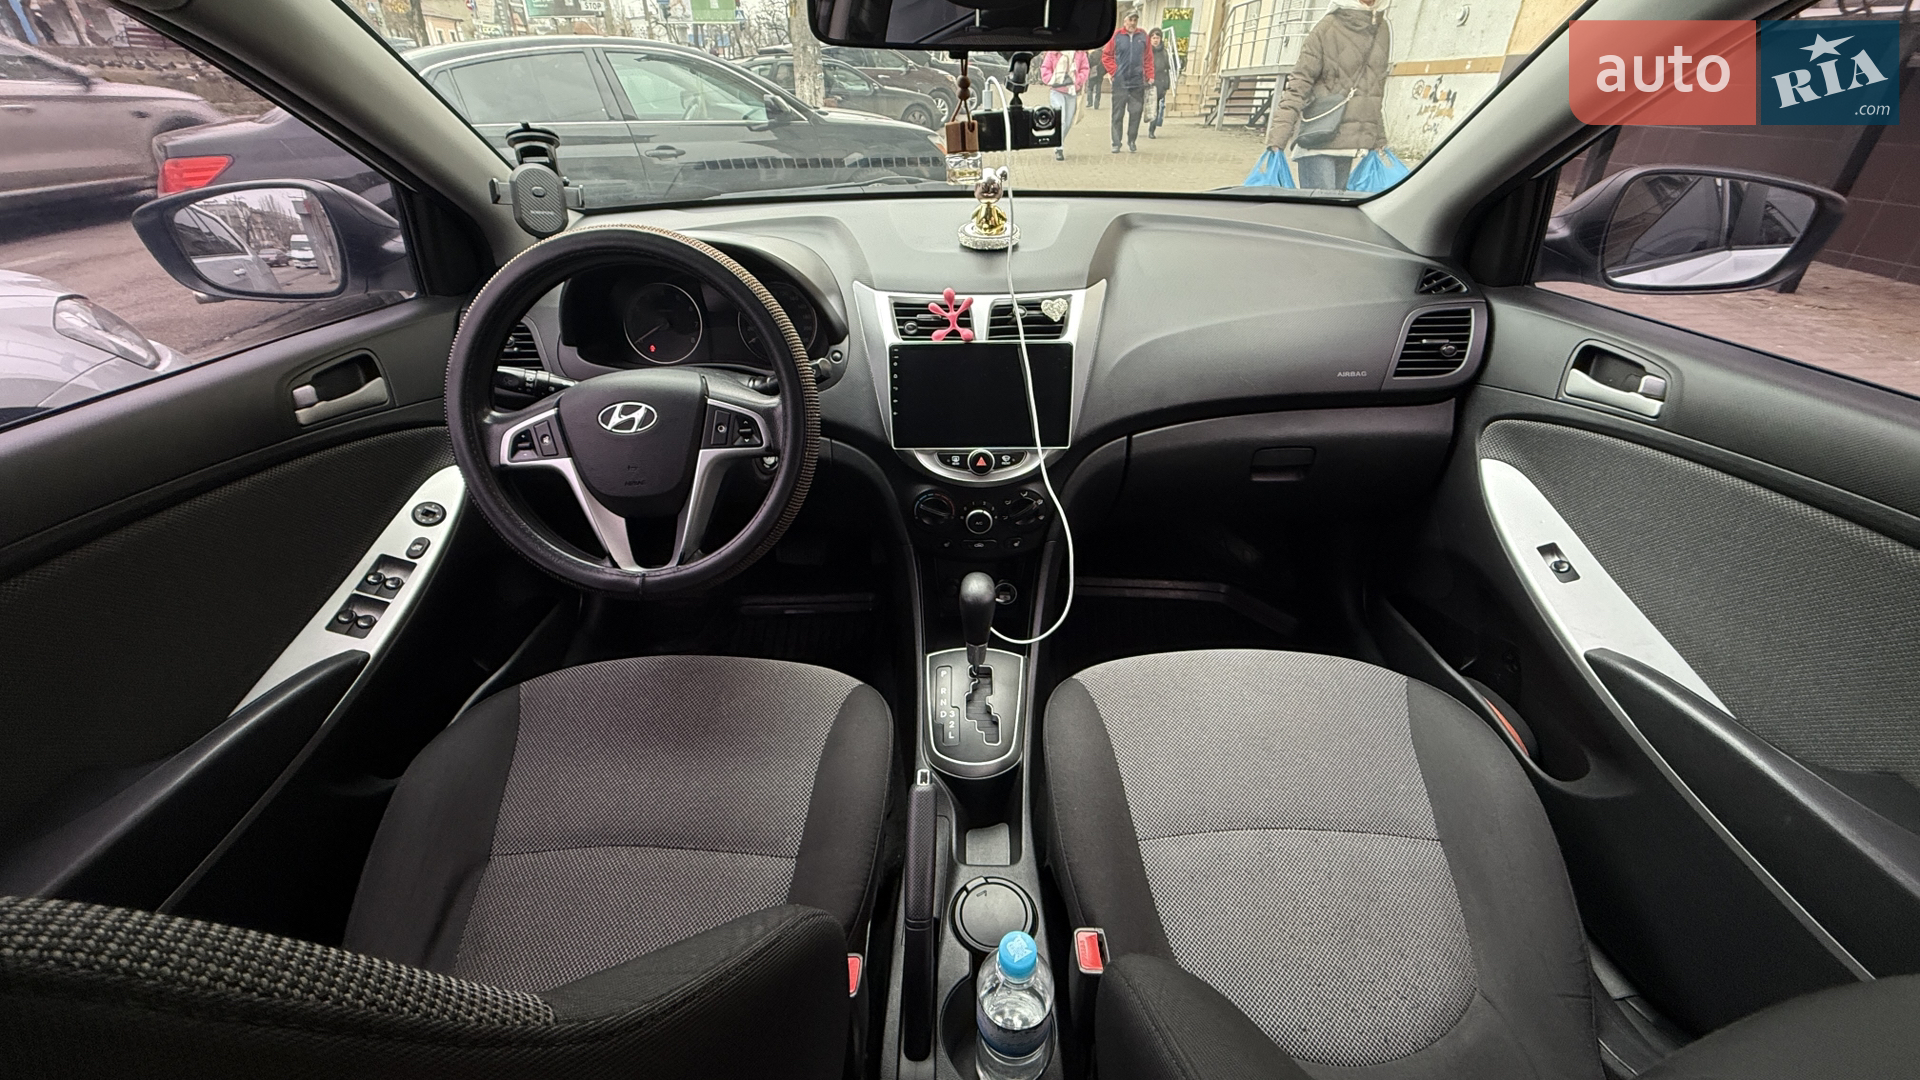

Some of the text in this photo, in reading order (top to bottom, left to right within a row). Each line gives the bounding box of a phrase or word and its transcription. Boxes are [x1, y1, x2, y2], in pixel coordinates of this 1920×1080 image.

[585, 2, 602, 10] STOP
[941, 687, 947, 695] R
[949, 710, 956, 718] 3
[949, 731, 955, 739] L
